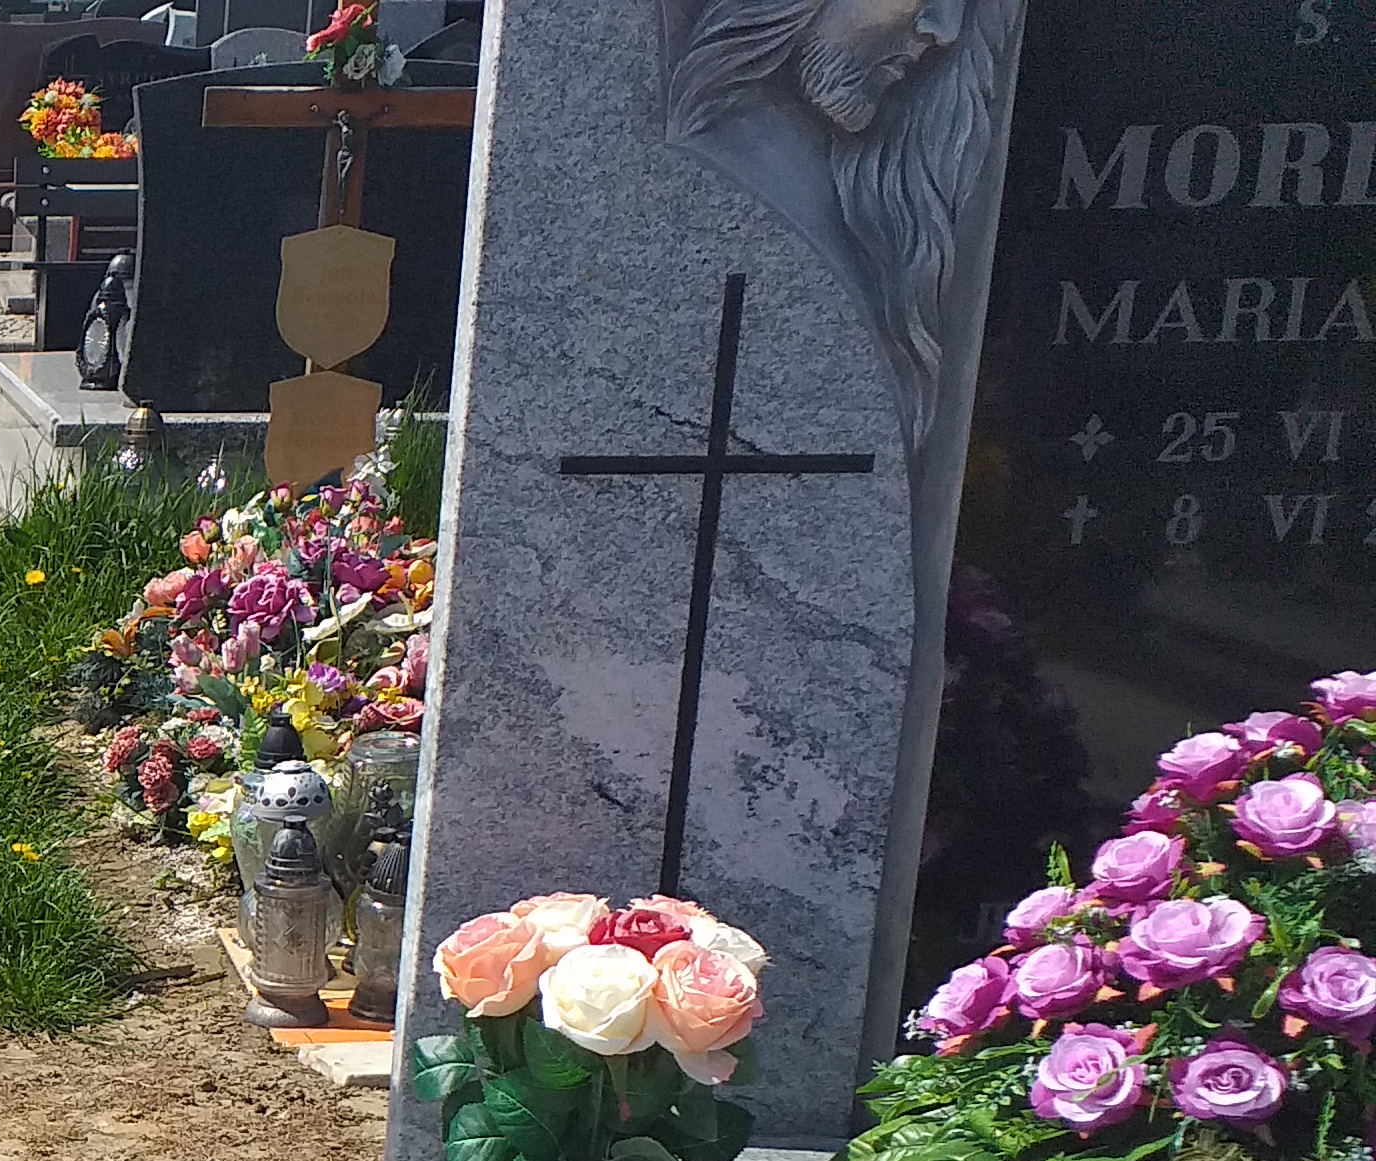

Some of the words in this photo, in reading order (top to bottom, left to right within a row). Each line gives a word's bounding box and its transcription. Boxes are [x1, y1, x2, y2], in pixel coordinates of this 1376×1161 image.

[1156, 413, 1240, 463] 25
[1278, 410, 1346, 463] VI
[1165, 494, 1203, 546] 8
[1262, 493, 1338, 545] VI
